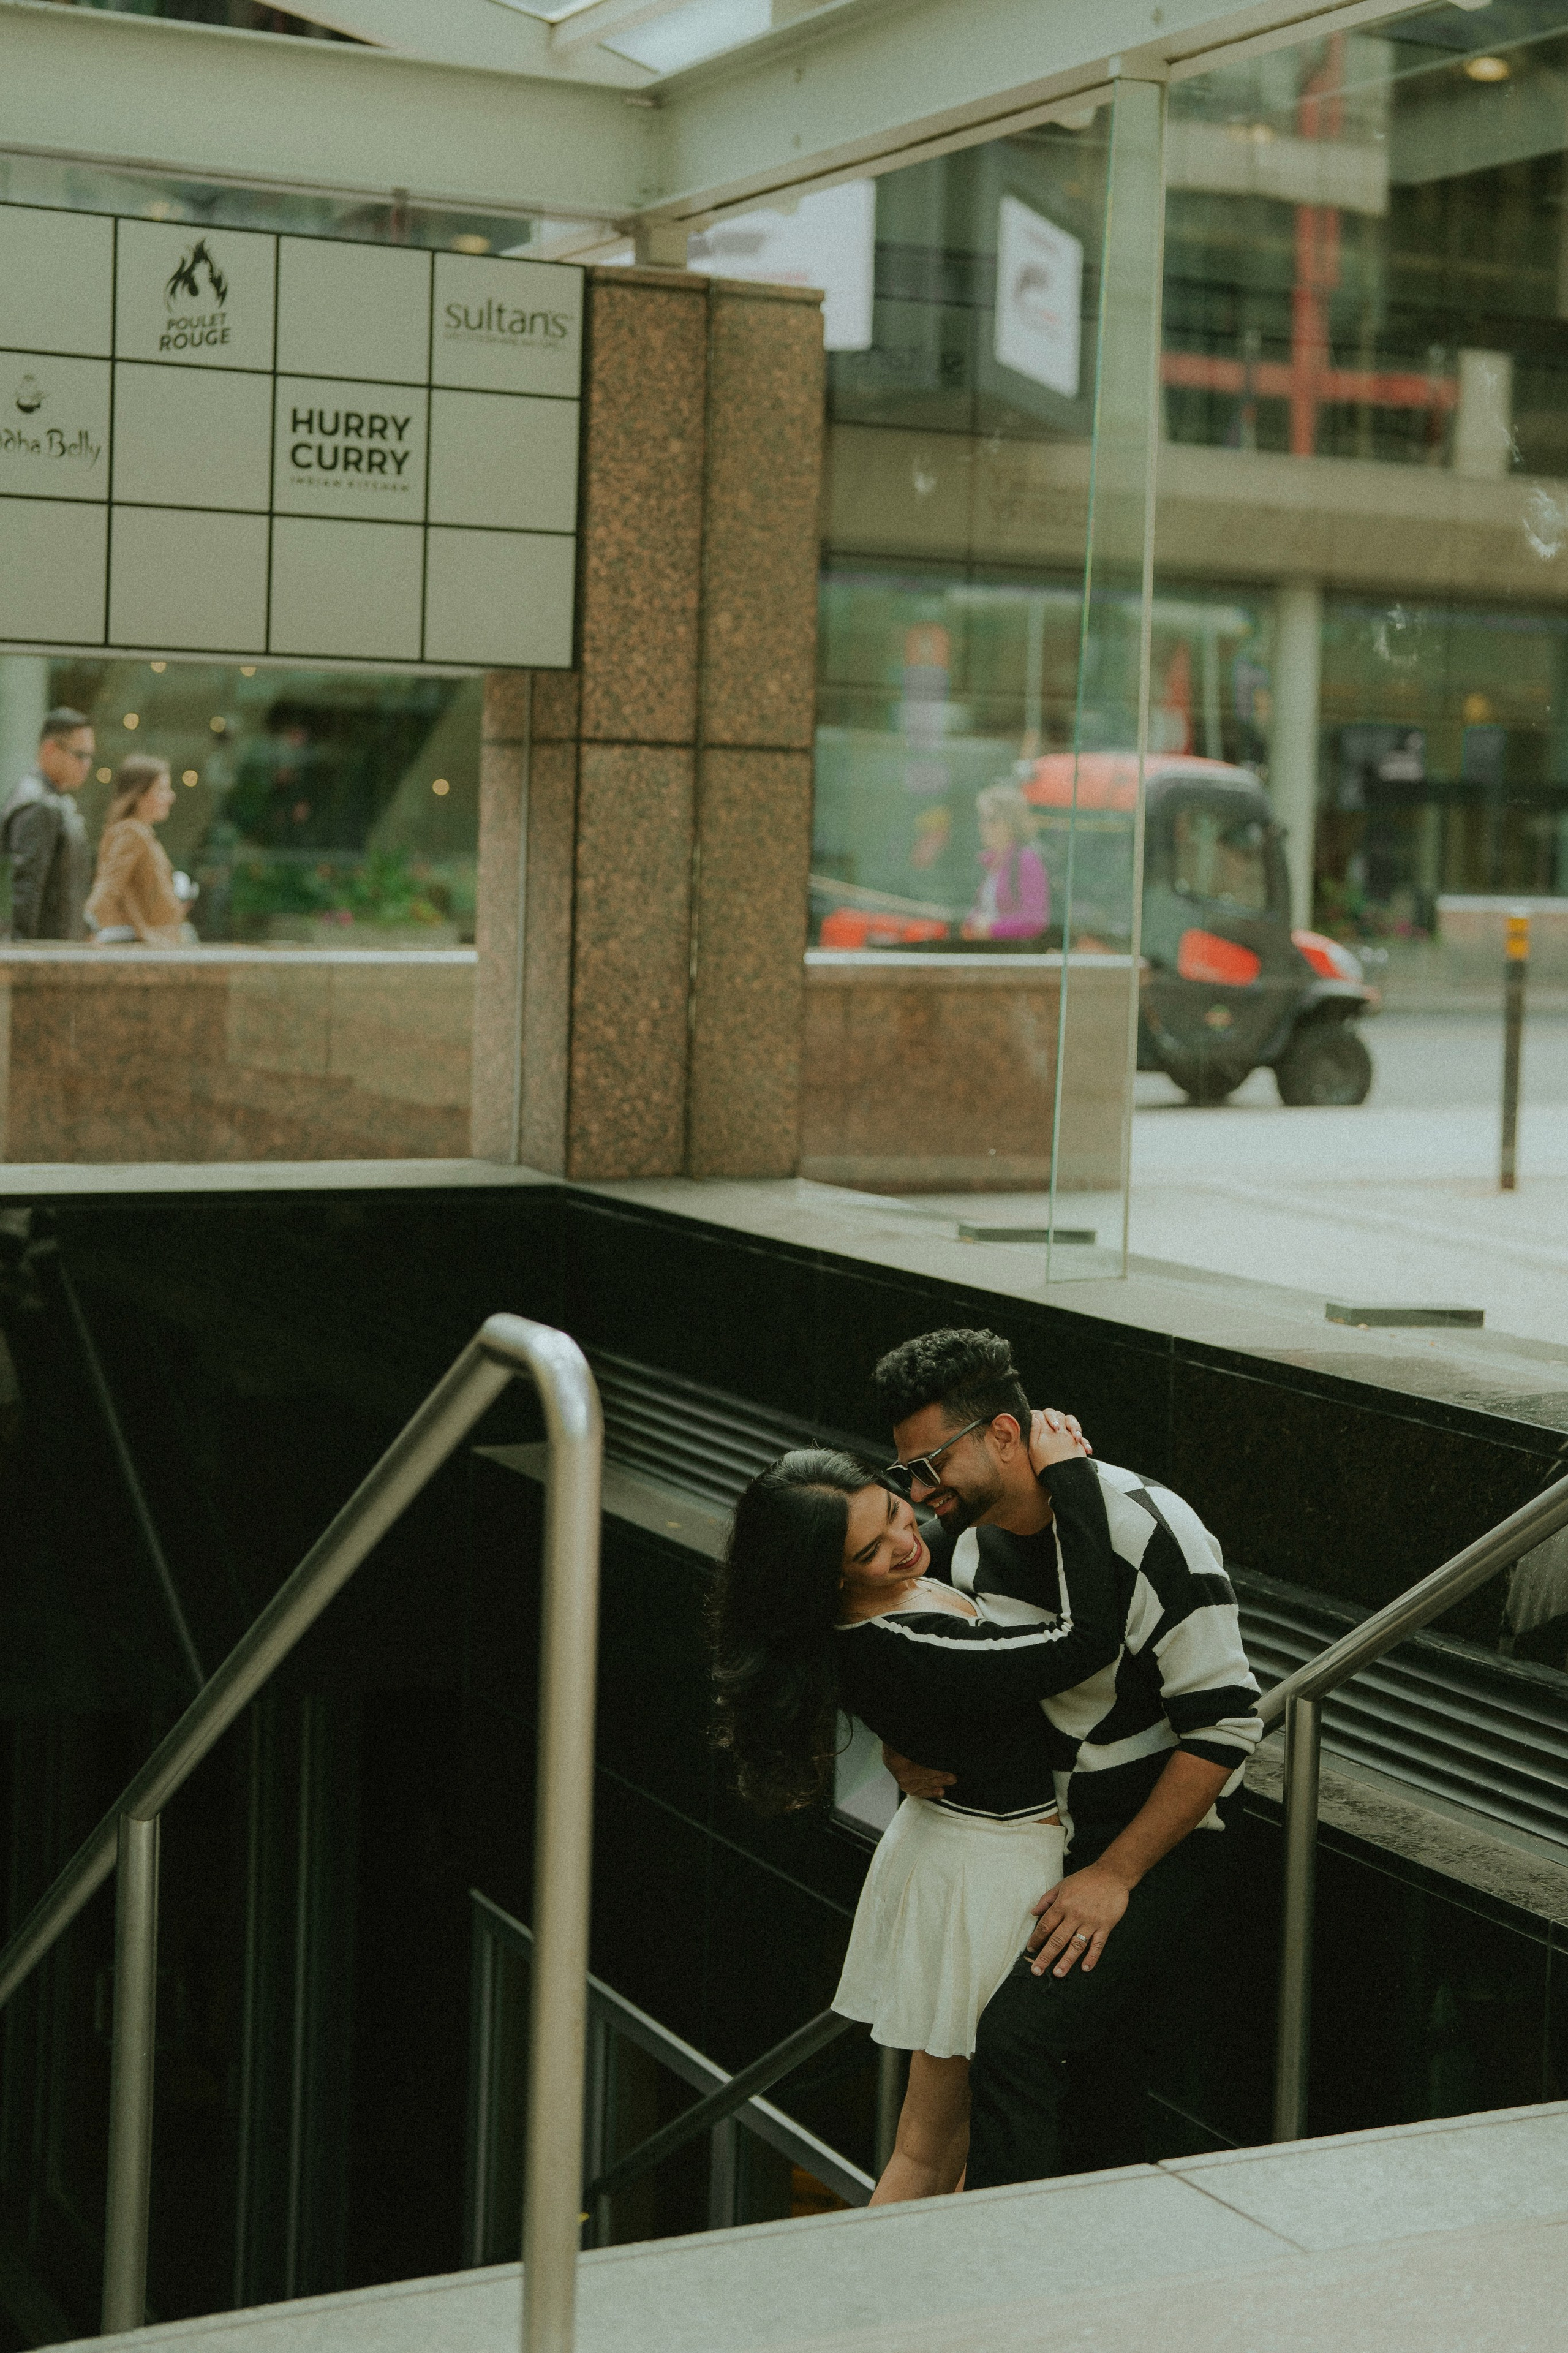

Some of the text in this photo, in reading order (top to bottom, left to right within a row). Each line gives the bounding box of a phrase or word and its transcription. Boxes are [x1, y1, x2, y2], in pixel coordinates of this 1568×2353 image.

[159, 328, 231, 351] ROUGE
[292, 408, 411, 440] HURRY
[0, 428, 101, 468] dha Belly
[291, 442, 410, 475] CURRY
